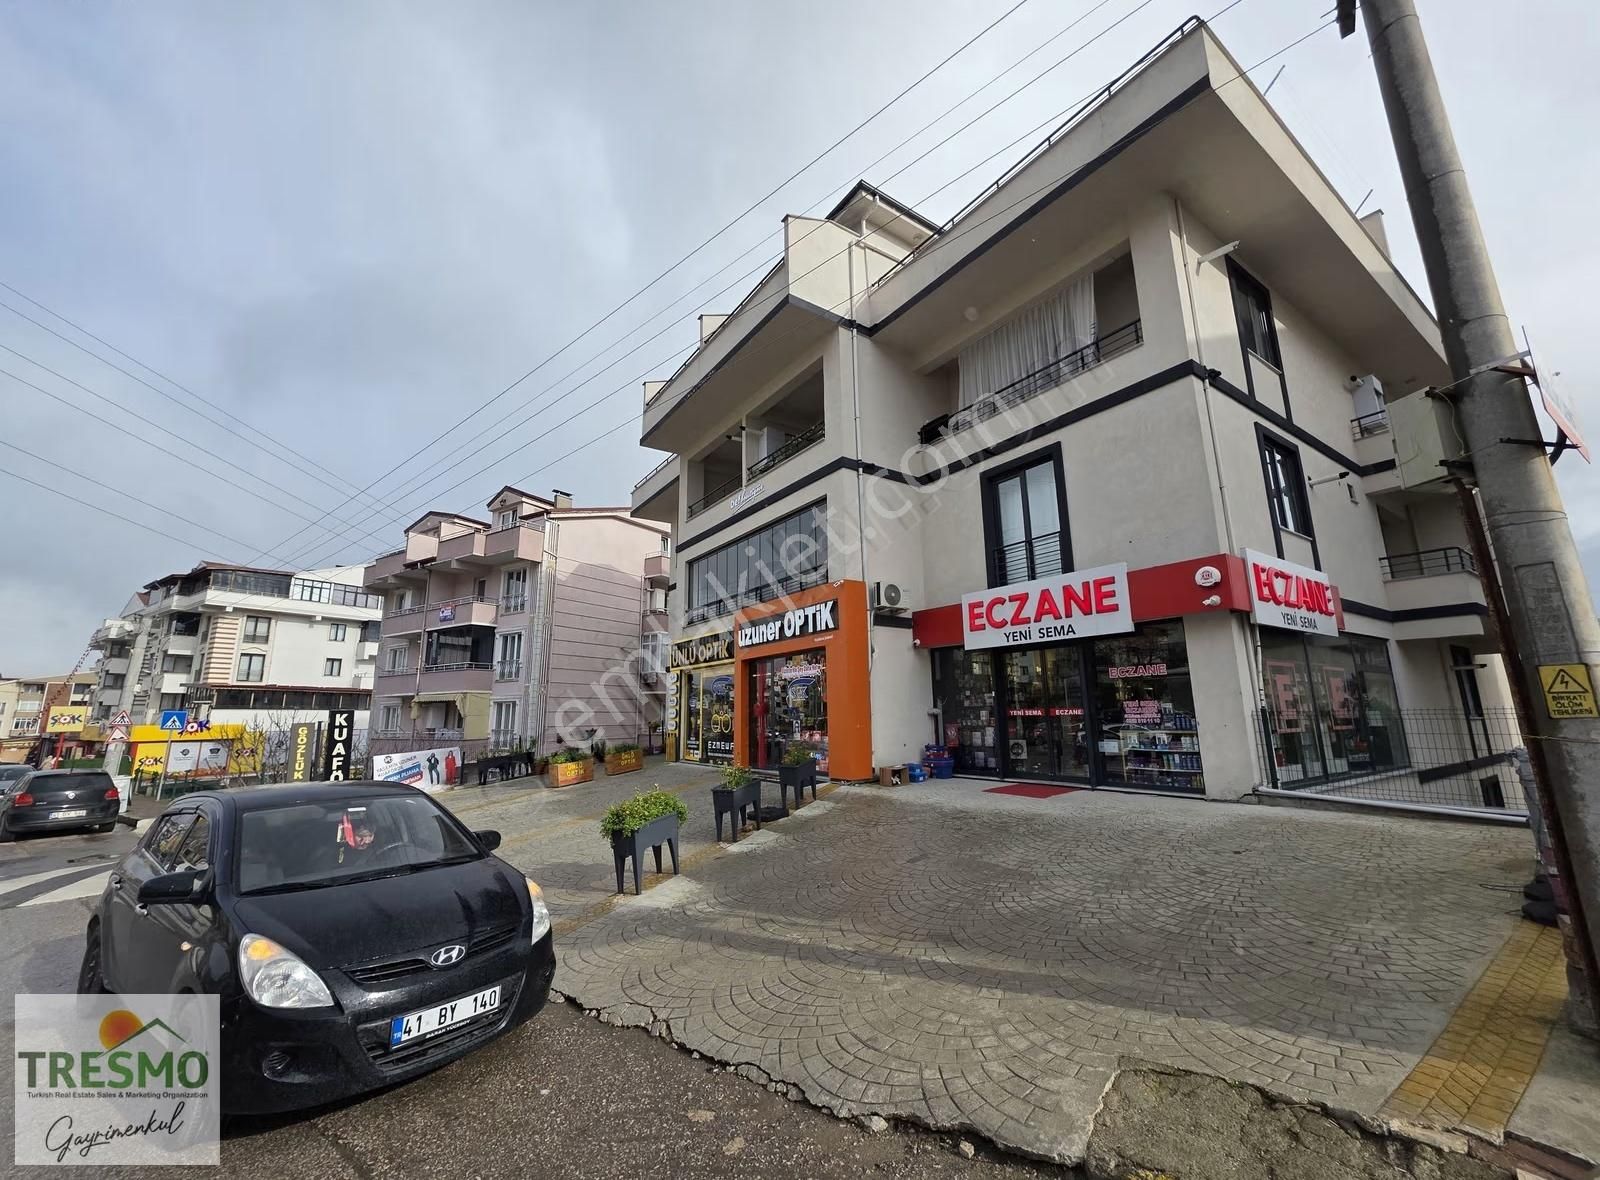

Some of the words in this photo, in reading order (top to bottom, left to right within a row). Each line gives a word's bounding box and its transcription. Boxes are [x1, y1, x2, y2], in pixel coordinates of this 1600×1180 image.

[1252, 562, 1335, 617] ECZANE
[968, 576, 1119, 632] ECZANE
[1004, 626, 1032, 643] YENİ
[1038, 624, 1076, 639] SEMA
[1281, 611, 1298, 628] YENİ
[1300, 615, 1318, 631] SEMA
[738, 620, 781, 648] uzuner
[672, 641, 696, 666] ÜNLÜ
[1108, 664, 1167, 679] ECZANE
[1009, 708, 1024, 716] YENİ
[1055, 708, 1082, 716] ECZANE
[293, 726, 309, 780] GÖZLÜK
[329, 713, 350, 782] KUAFÖ
[403, 1014, 423, 1037] 41
[438, 1003, 458, 1026] BY
[472, 989, 497, 1013] 140
[393, 1032, 402, 1040] TR
